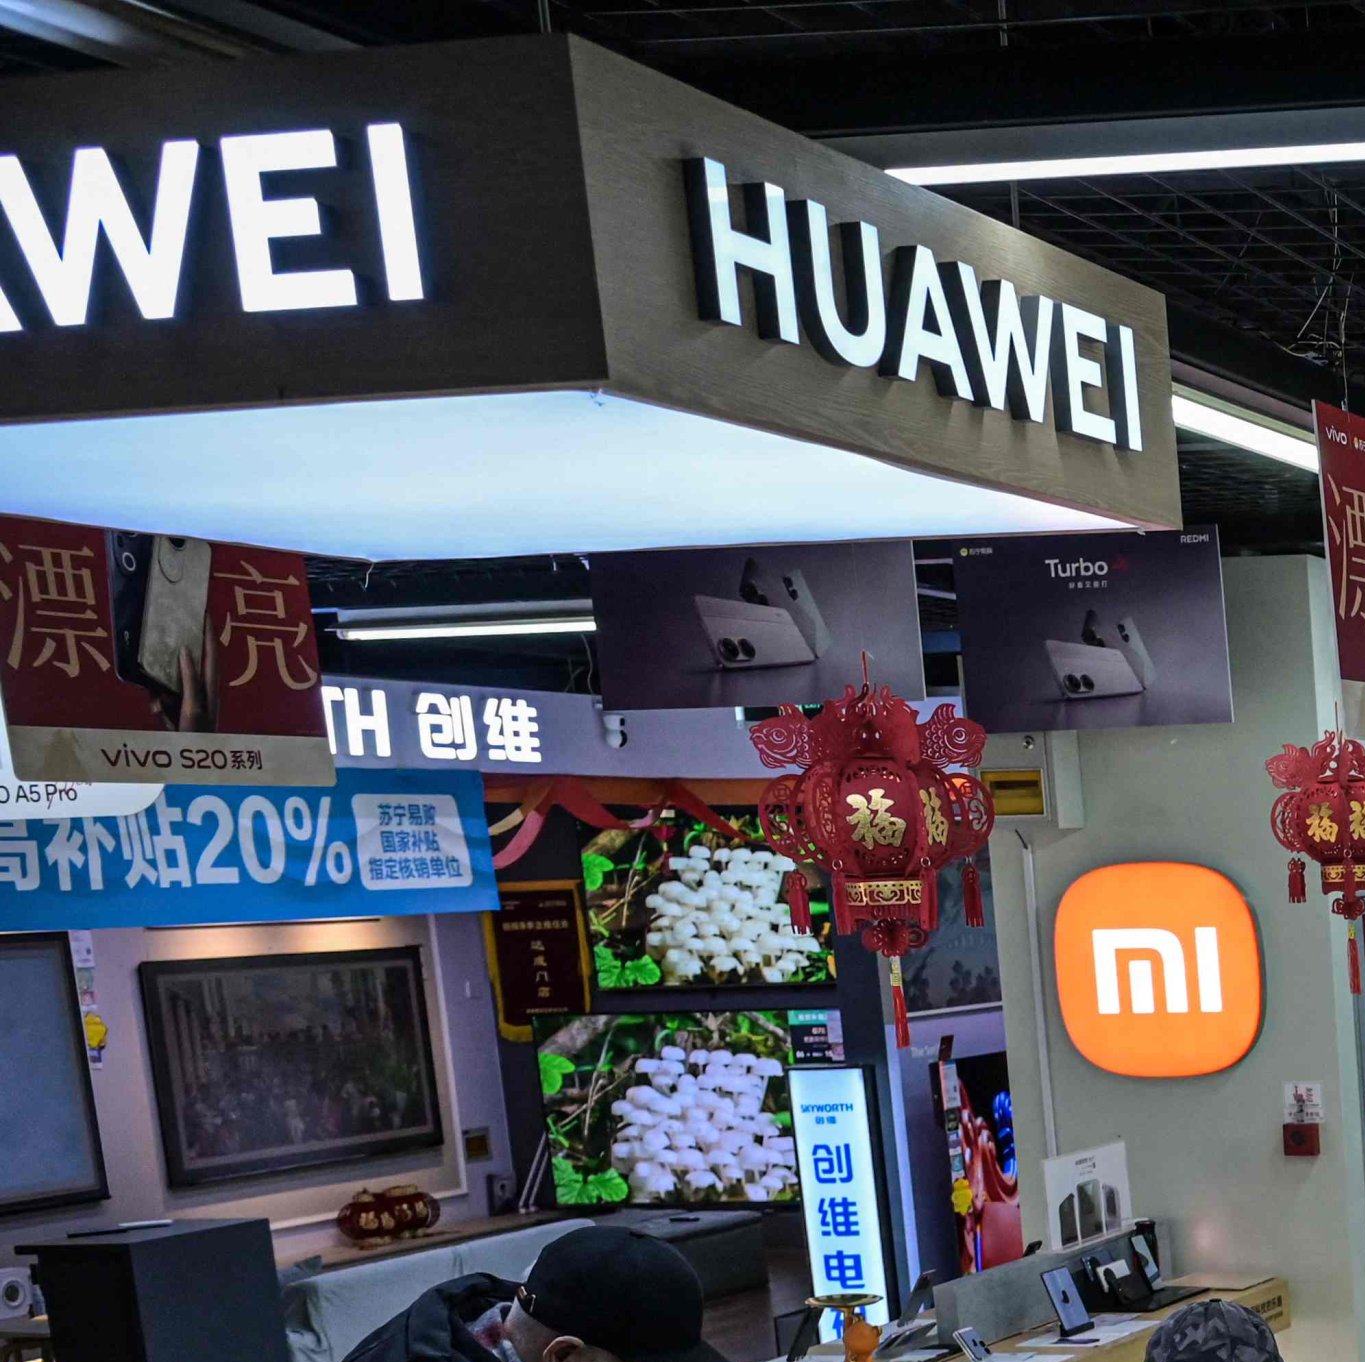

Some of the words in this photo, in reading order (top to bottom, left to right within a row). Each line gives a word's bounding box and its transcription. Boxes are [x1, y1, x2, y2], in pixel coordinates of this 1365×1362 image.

[700, 156, 1143, 452] HUAWEI
[1325, 425, 1347, 445] vivo
[1179, 533, 1210, 544] REDMI
[1045, 556, 1109, 579] Turbo
[0, 541, 112, 679] 漂
[212, 560, 320, 691] 亮
[415, 691, 543, 764] 创维
[102, 742, 173, 770] vivo
[180, 748, 263, 772] S20系列
[15, 784, 41, 803] A5
[45, 782, 78, 803] Pro
[378, 803, 437, 828] 苏宁易购
[845, 788, 908, 851] 福
[1306, 803, 1340, 844] 福
[380, 830, 441, 855] 国家补贴
[367, 856, 464, 882] 指定核销单位
[800, 1102, 854, 1114] SKYWORTH
[814, 1115, 838, 1125] 创维
